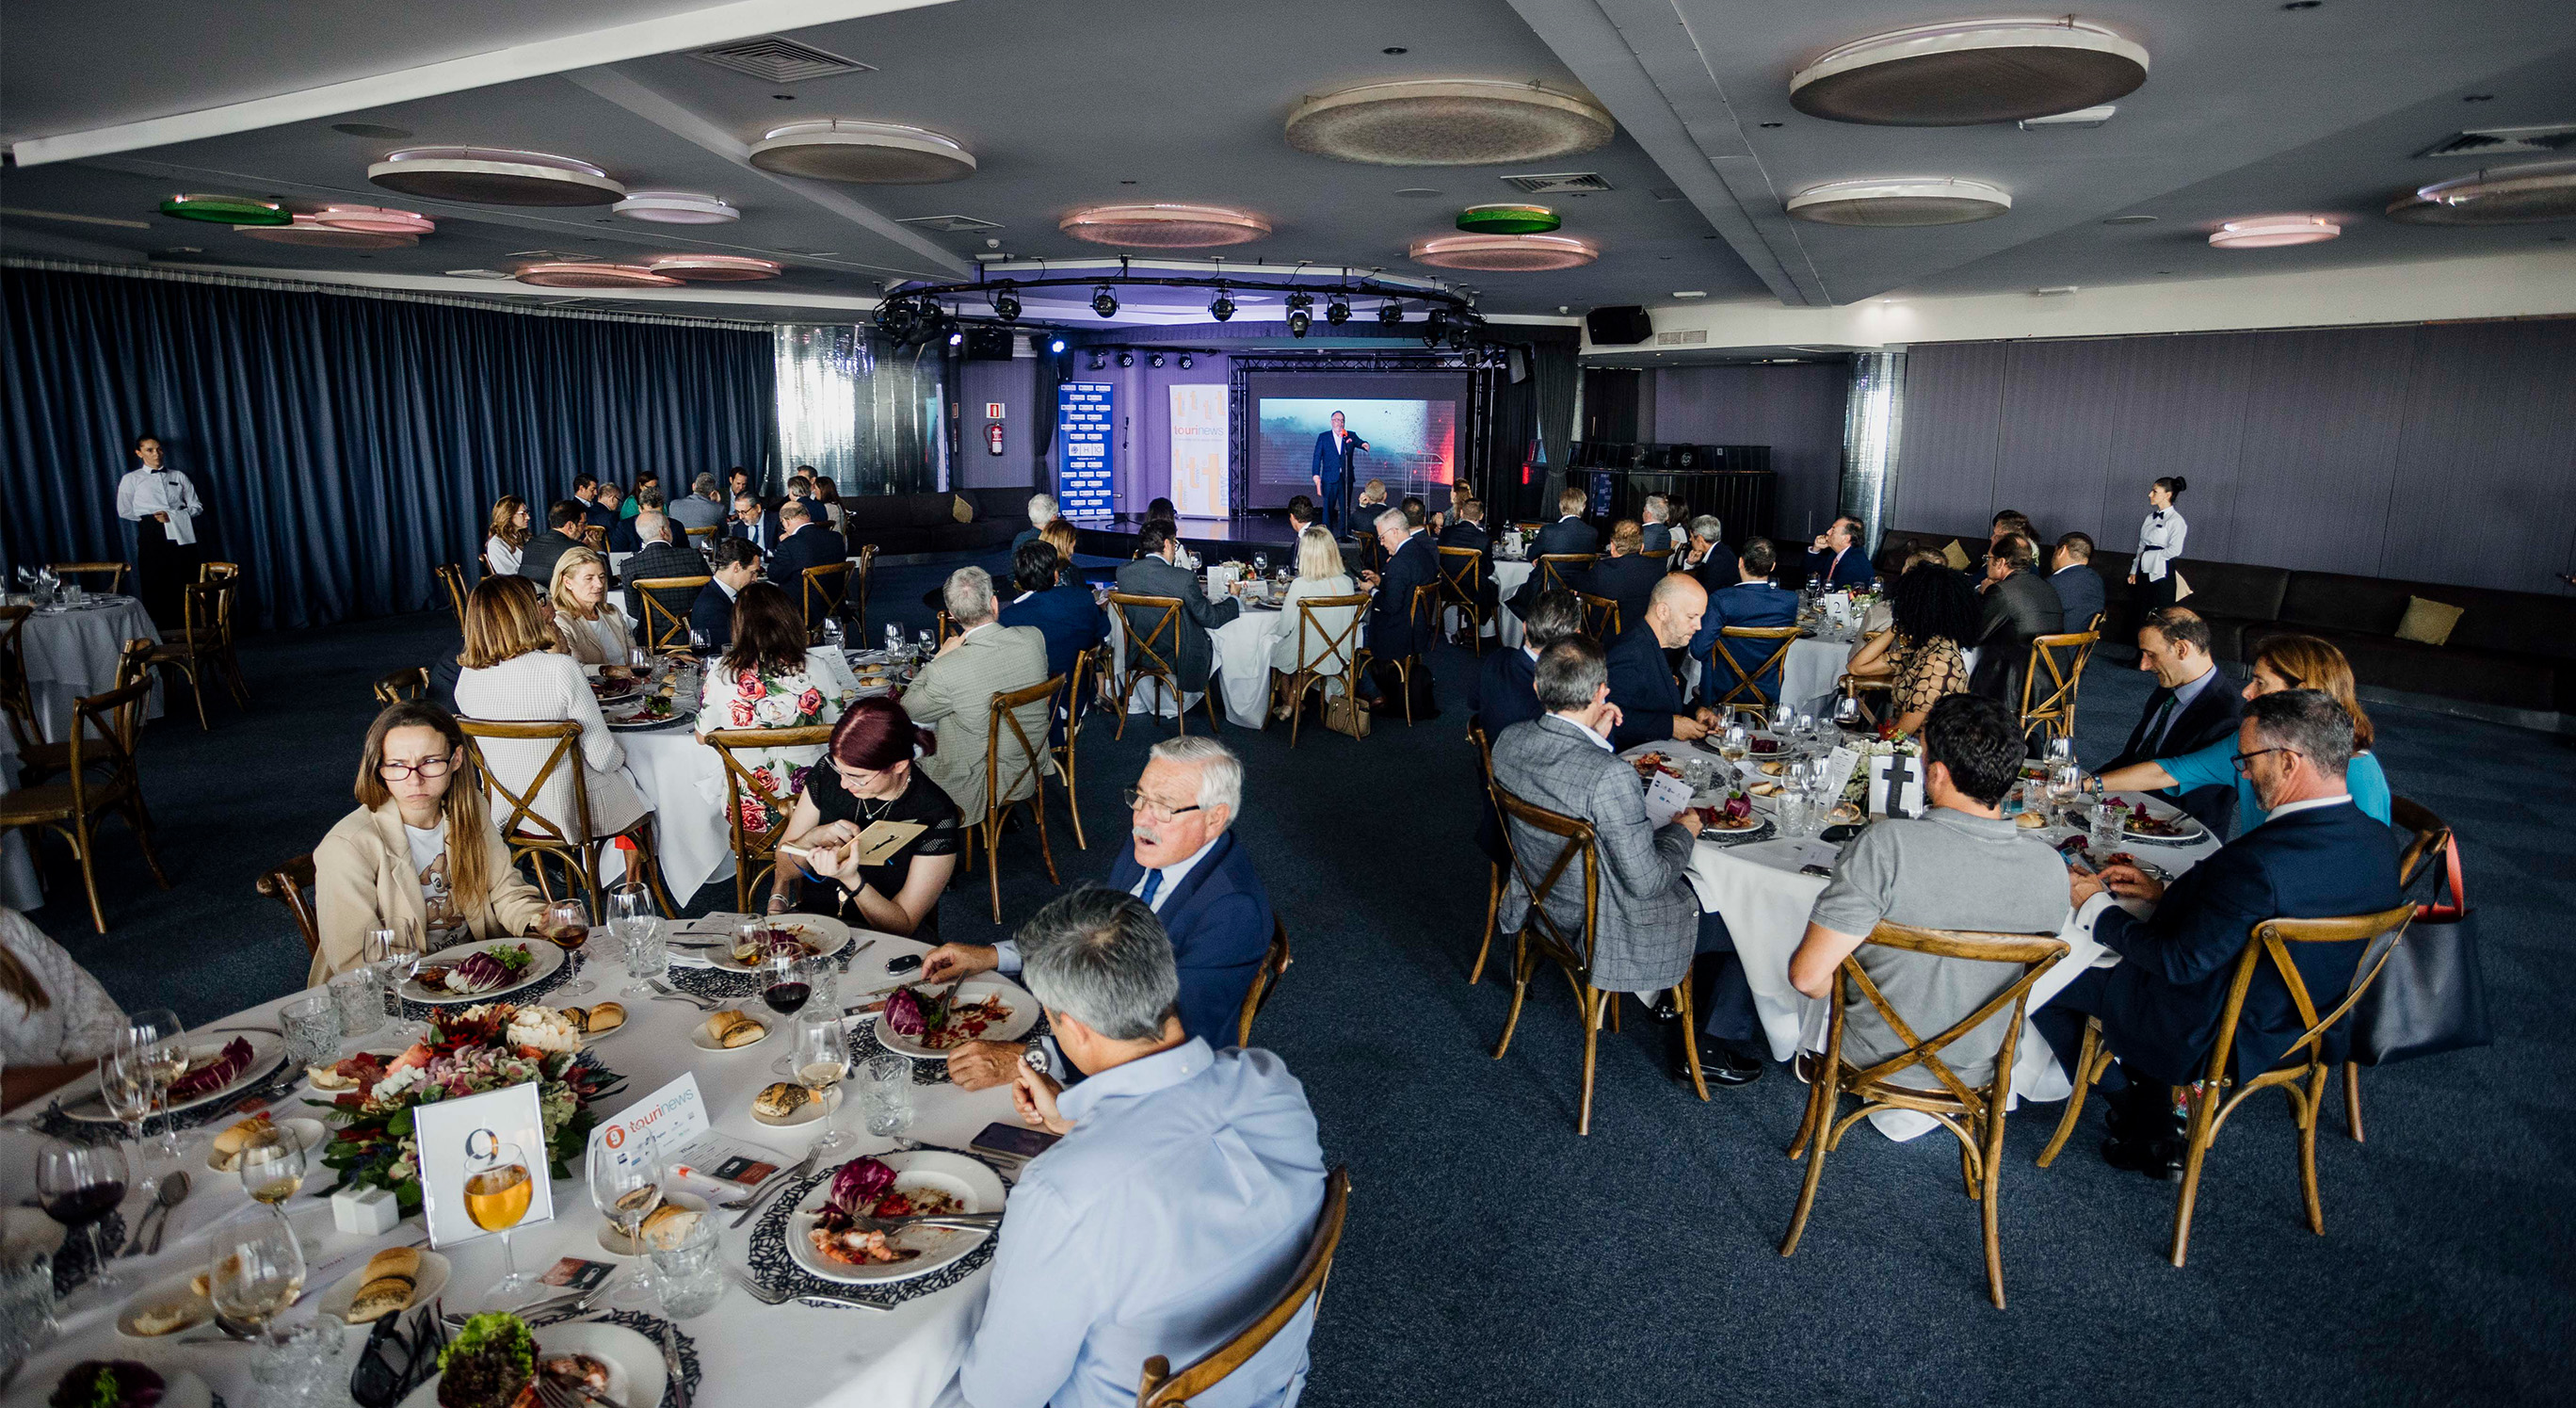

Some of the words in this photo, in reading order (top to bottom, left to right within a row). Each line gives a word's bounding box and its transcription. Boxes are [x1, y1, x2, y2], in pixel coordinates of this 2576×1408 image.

[1174, 425, 1224, 436] tourinews
[1833, 601, 1842, 613] 2
[629, 1087, 695, 1133] tourinews
[465, 1128, 499, 1166] 9
